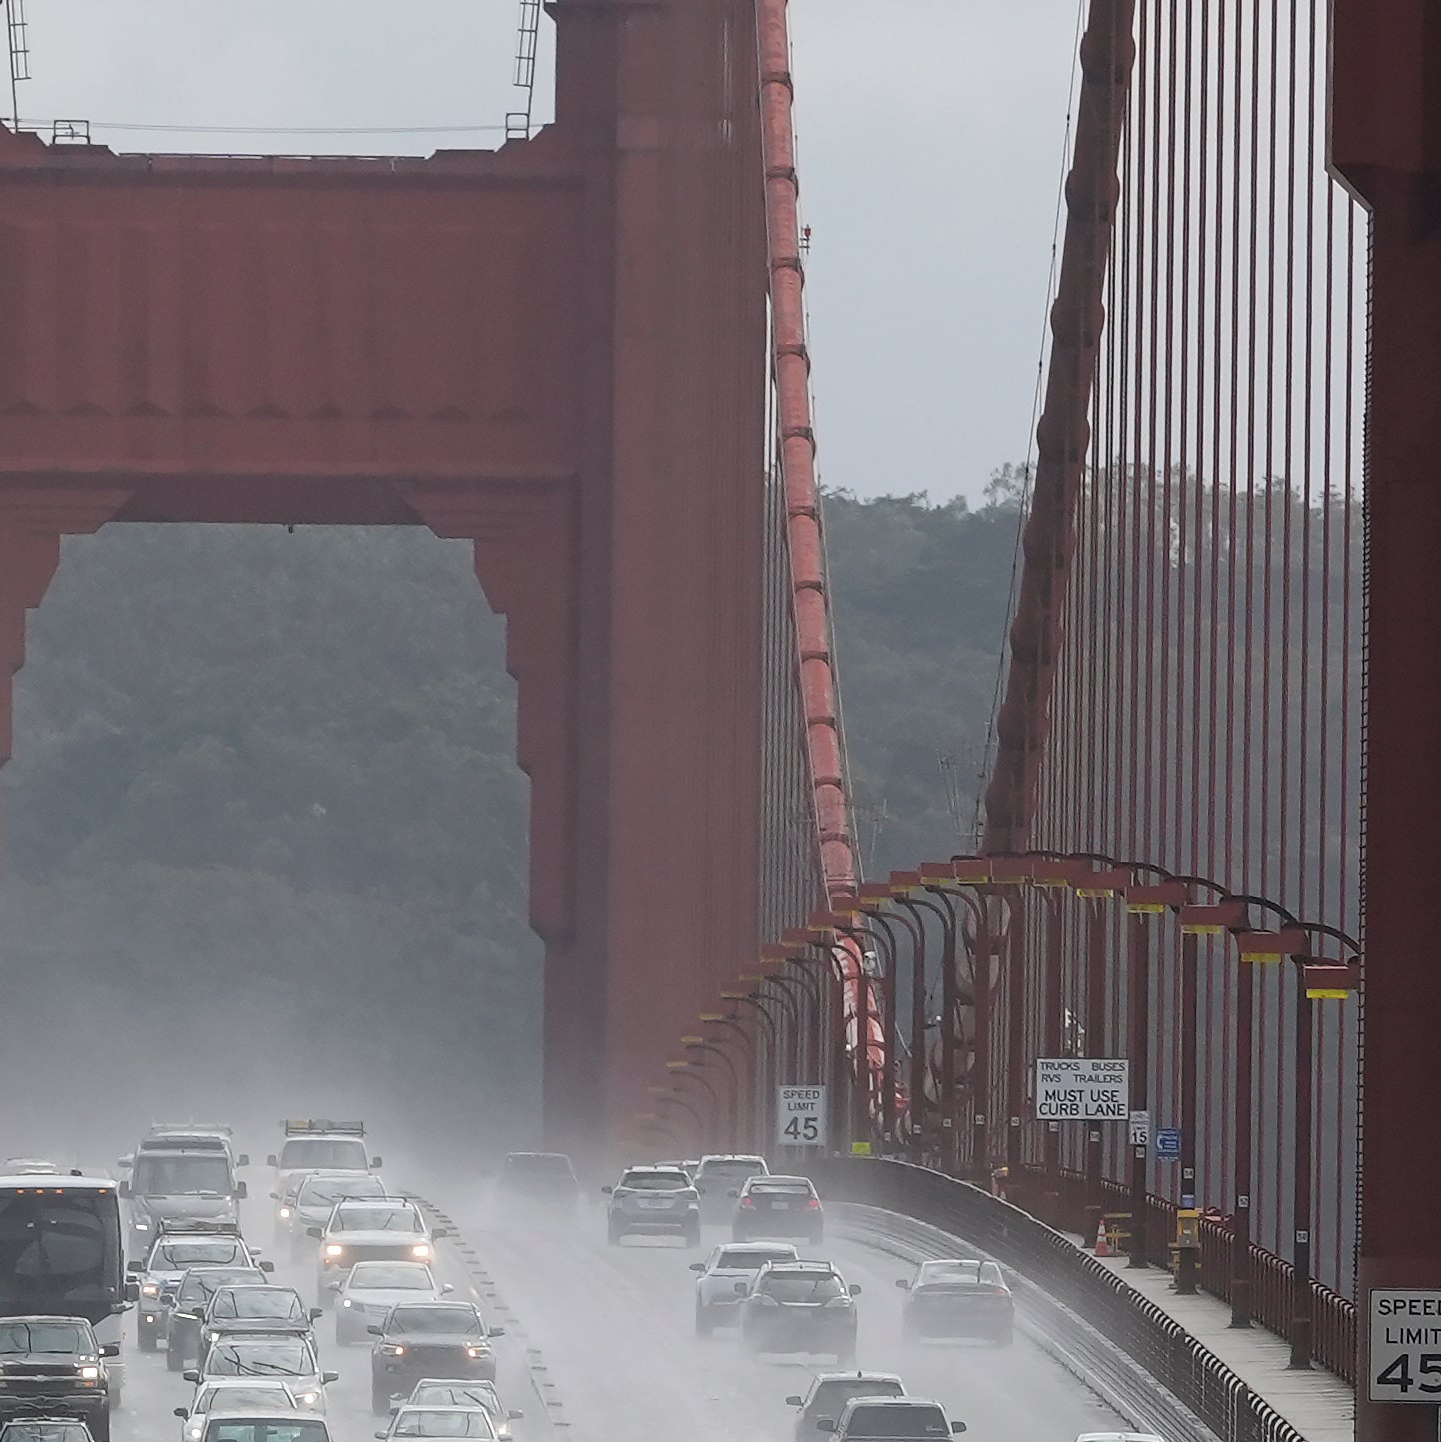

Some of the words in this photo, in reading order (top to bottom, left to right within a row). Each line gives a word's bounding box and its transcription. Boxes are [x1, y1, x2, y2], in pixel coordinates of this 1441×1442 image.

[1040, 1061, 1080, 1071] TRUCKS
[1092, 1062, 1125, 1071] BUSES
[1041, 1074, 1061, 1083] RVS
[1074, 1074, 1123, 1083] TRAILERS
[783, 1090, 820, 1099] SPEED
[1045, 1089, 1085, 1102] MUST
[1091, 1090, 1120, 1102] USE
[788, 1102, 815, 1111] LIMIT
[1039, 1103, 1079, 1116] CURB
[1085, 1103, 1126, 1116] LANE
[784, 1116, 818, 1140] 45
[1132, 1131, 1147, 1143] 15
[1386, 1328, 1441, 1344] LIMIT
